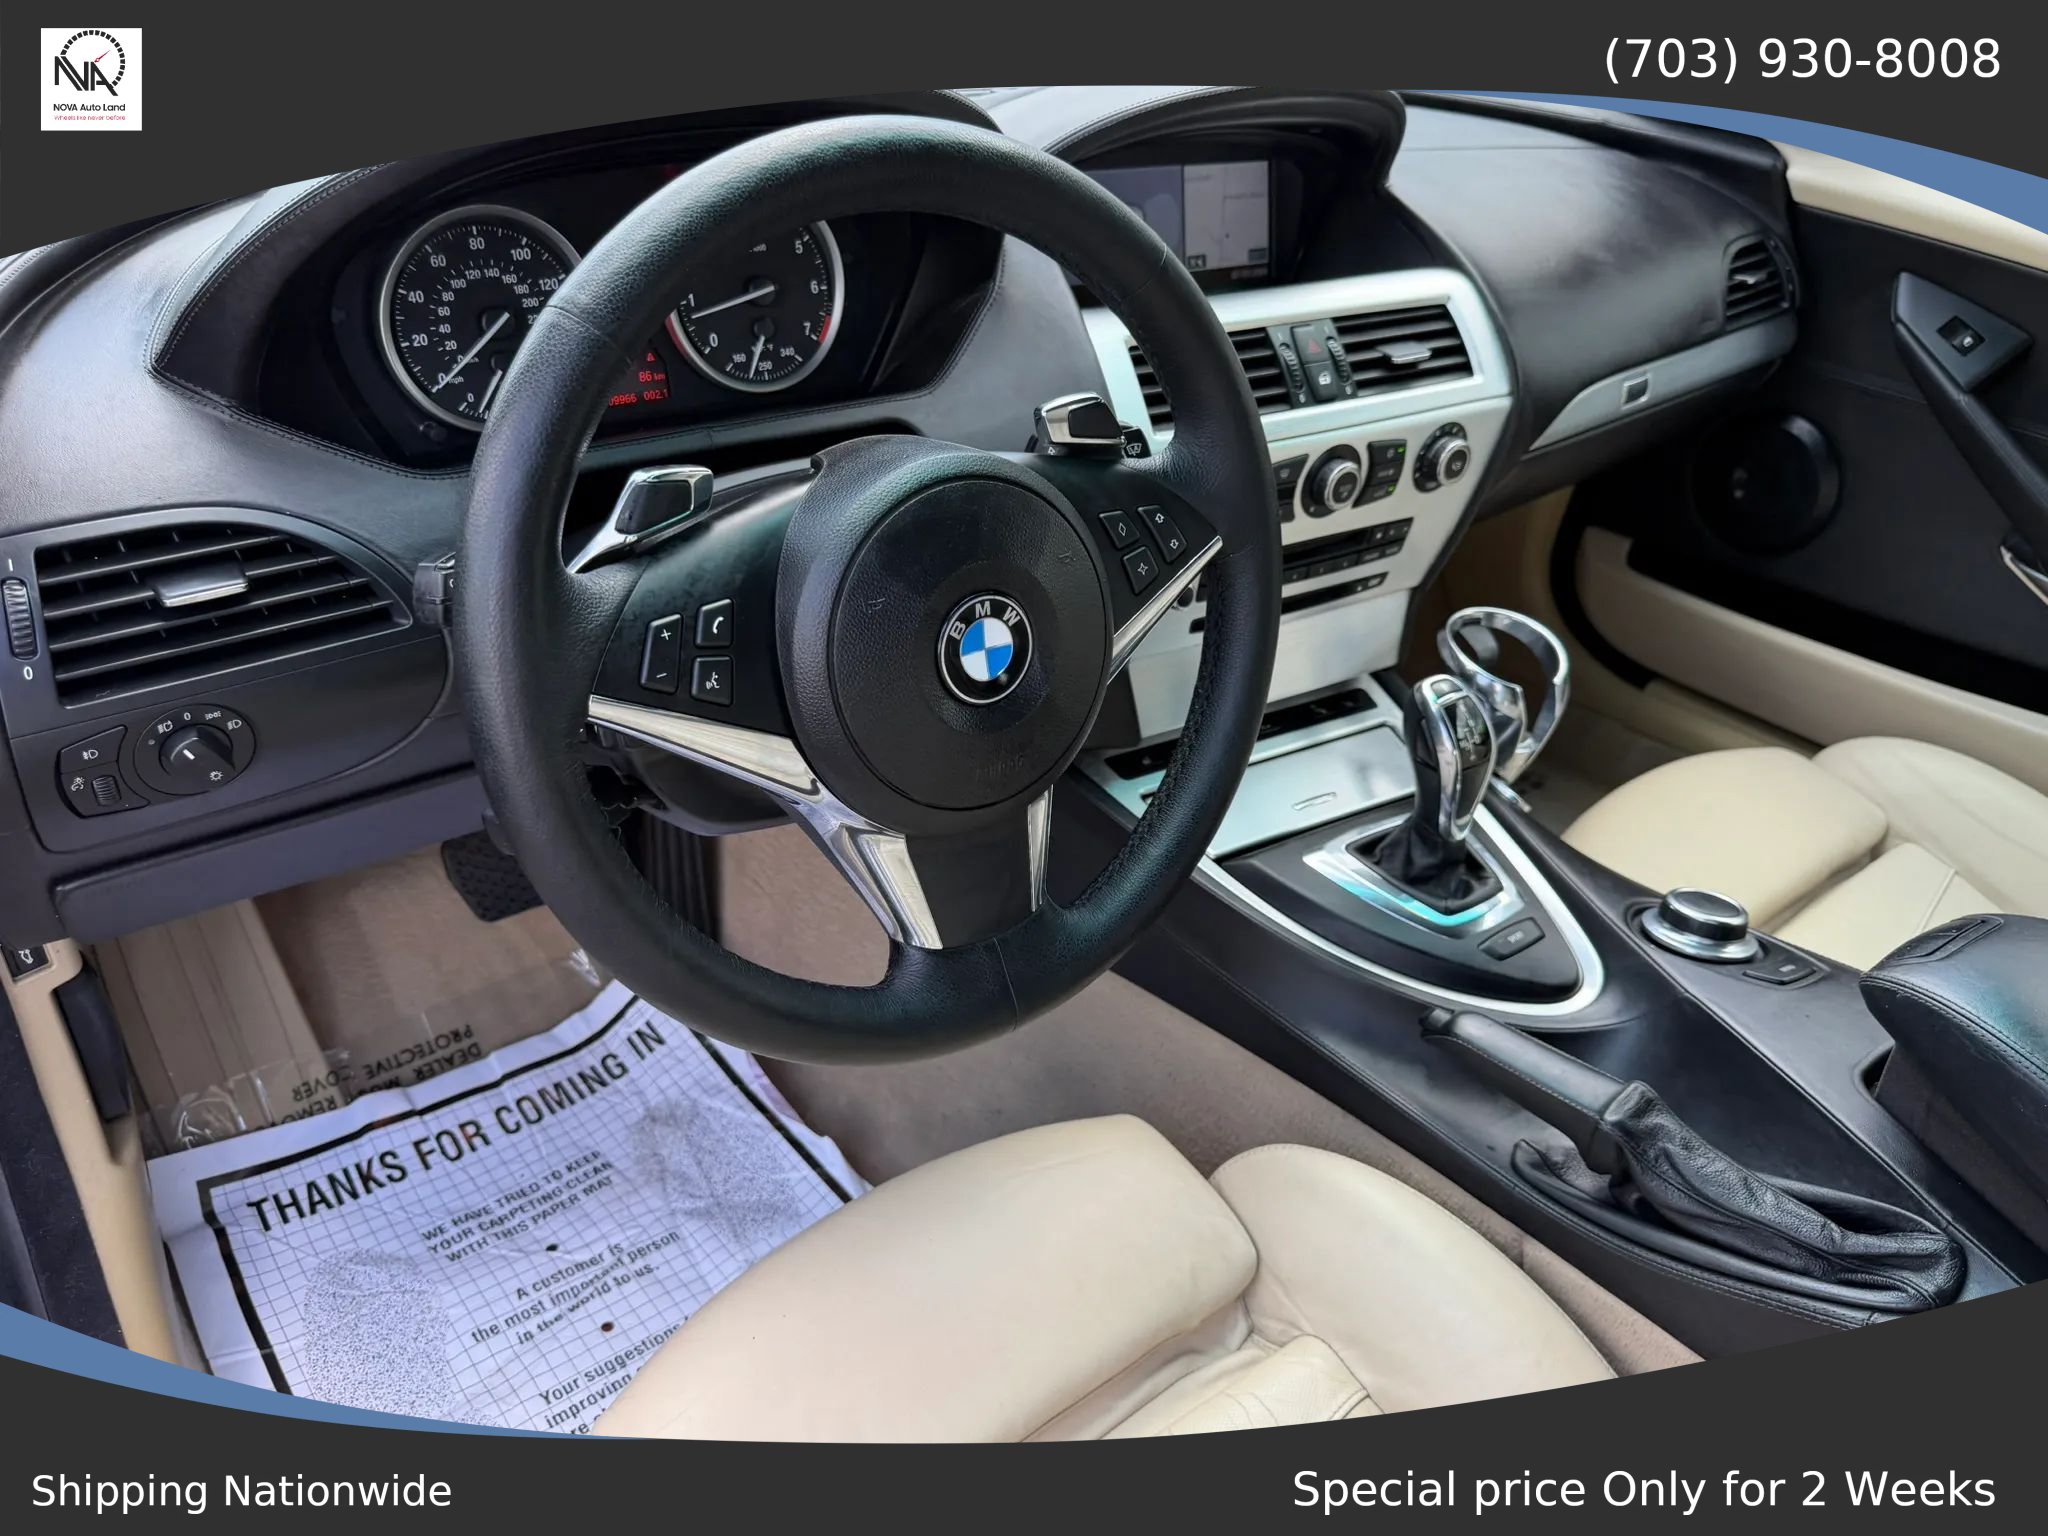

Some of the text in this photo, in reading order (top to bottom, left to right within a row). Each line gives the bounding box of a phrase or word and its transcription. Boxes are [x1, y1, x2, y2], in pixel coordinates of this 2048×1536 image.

[469, 237, 485, 250] 80
[795, 240, 803, 254] 5
[430, 254, 446, 268] 60
[511, 248, 531, 261] 100
[465, 270, 481, 280] 120
[484, 268, 500, 278] 140
[502, 274, 517, 284] 160
[450, 279, 466, 290] 100
[514, 284, 529, 294] 180
[539, 278, 559, 291] 120
[810, 280, 819, 294] 6
[408, 290, 424, 304] 40
[442, 292, 454, 302] 80
[522, 297, 539, 308] 200
[688, 293, 695, 307] 1
[438, 307, 450, 317] 60
[438, 324, 451, 334] 40
[803, 322, 811, 335] 7
[412, 333, 428, 347] 20
[445, 341, 457, 351] 20
[709, 333, 719, 348] 0
[759, 361, 772, 371] 250
[467, 393, 474, 403] 0
[24, 666, 33, 680] 0
[184, 712, 191, 721] 0
[362, 1024, 474, 1080] PROTECTIVE
[246, 1020, 667, 1232] THANKS FOR COMING IN
[421, 1150, 601, 1241] WE HAVE TRIED TO KEEP
[428, 1160, 614, 1254] YOUR CARPETING CLEAN
[445, 1175, 614, 1262] WITH THIS PAPER MAT
[516, 1242, 623, 1300] A customer is
[471, 1230, 681, 1344] the most important person
[517, 1264, 661, 1345] in the world to us.
[538, 1376, 581, 1405] Your
